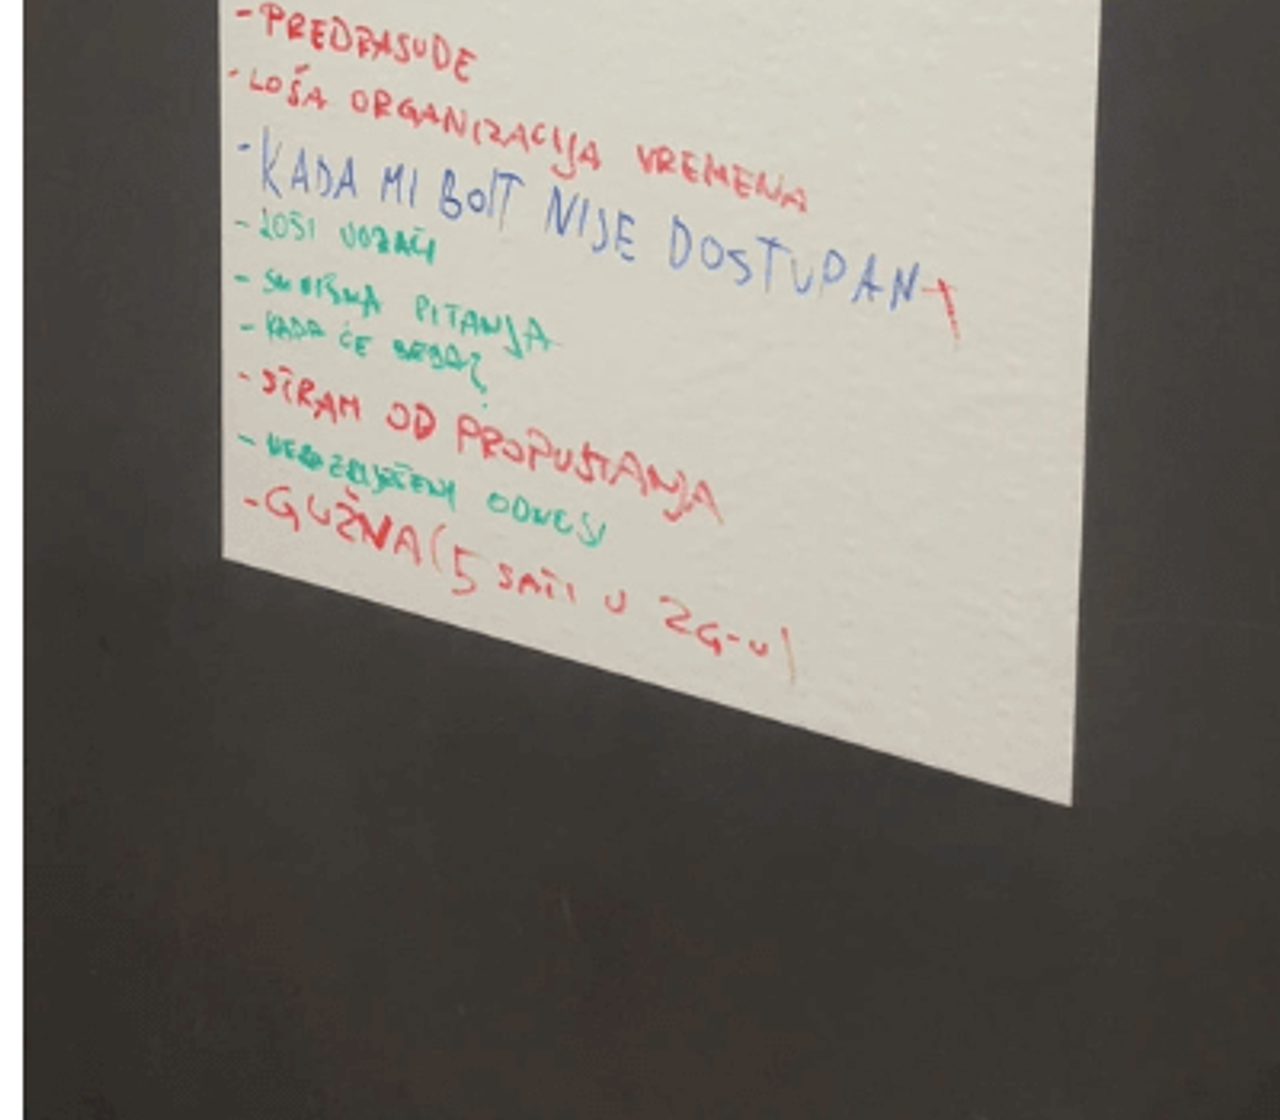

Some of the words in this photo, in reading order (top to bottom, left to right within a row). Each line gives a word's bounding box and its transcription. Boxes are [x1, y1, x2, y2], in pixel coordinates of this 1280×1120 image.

[259, 1, 478, 84] PREDRASUDE
[249, 63, 328, 110] LOŠA
[350, 89, 602, 181] ORGANIZACIJA
[635, 142, 809, 214] VREMENA
[261, 126, 358, 200] KADA
[381, 163, 418, 209] MI
[545, 185, 636, 262] NIJE
[669, 213, 920, 312] DOSTUPAN
[385, 401, 438, 442] OD
